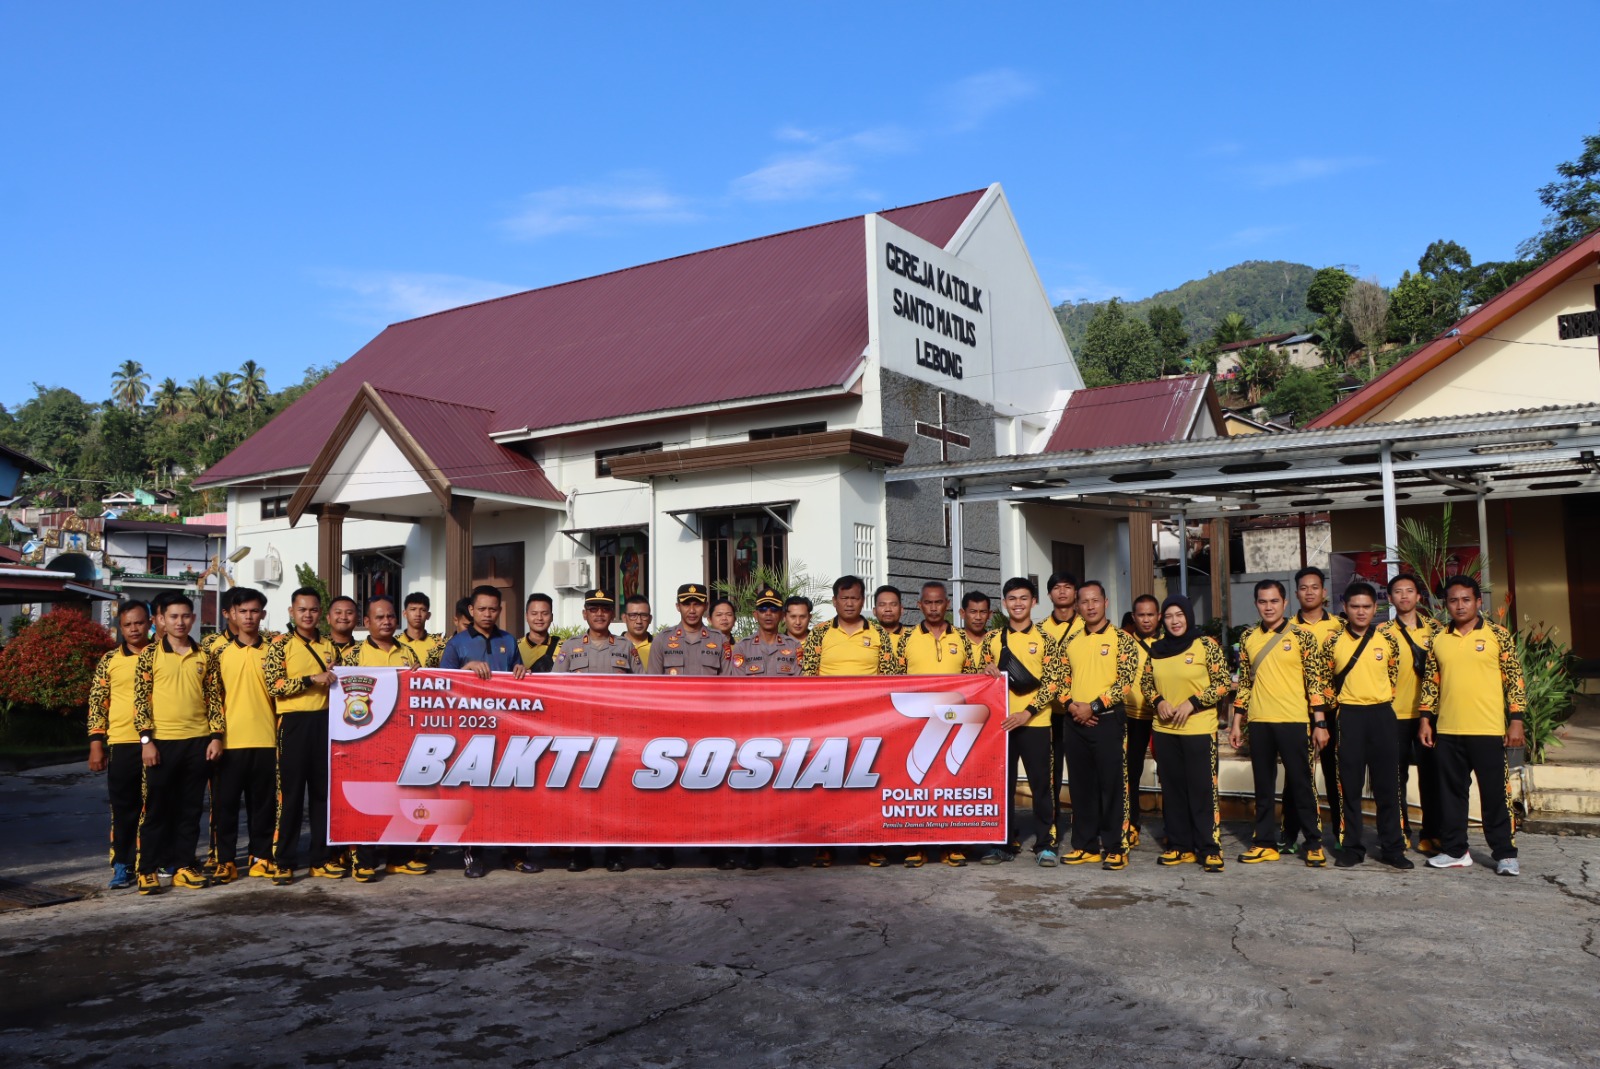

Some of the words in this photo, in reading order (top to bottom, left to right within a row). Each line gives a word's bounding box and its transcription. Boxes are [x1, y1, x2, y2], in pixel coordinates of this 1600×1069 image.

[886, 242, 935, 291] GEREJA
[937, 268, 982, 313] KATOLIK
[893, 288, 934, 329] SANTO
[937, 307, 976, 347] MATIUS
[916, 338, 962, 379] LEBONG
[410, 677, 451, 691] HARI
[410, 697, 544, 712] BHAYANGKARA
[409, 714, 414, 728] 1
[420, 715, 453, 728] JULI
[458, 715, 497, 729] 2023
[397, 734, 618, 789] BAKTI
[632, 737, 882, 789] SOSIAL
[882, 788, 929, 800] POLRI
[934, 788, 992, 800] PRESISI
[882, 804, 938, 818] UNTUK
[943, 804, 999, 817] NEGERI
